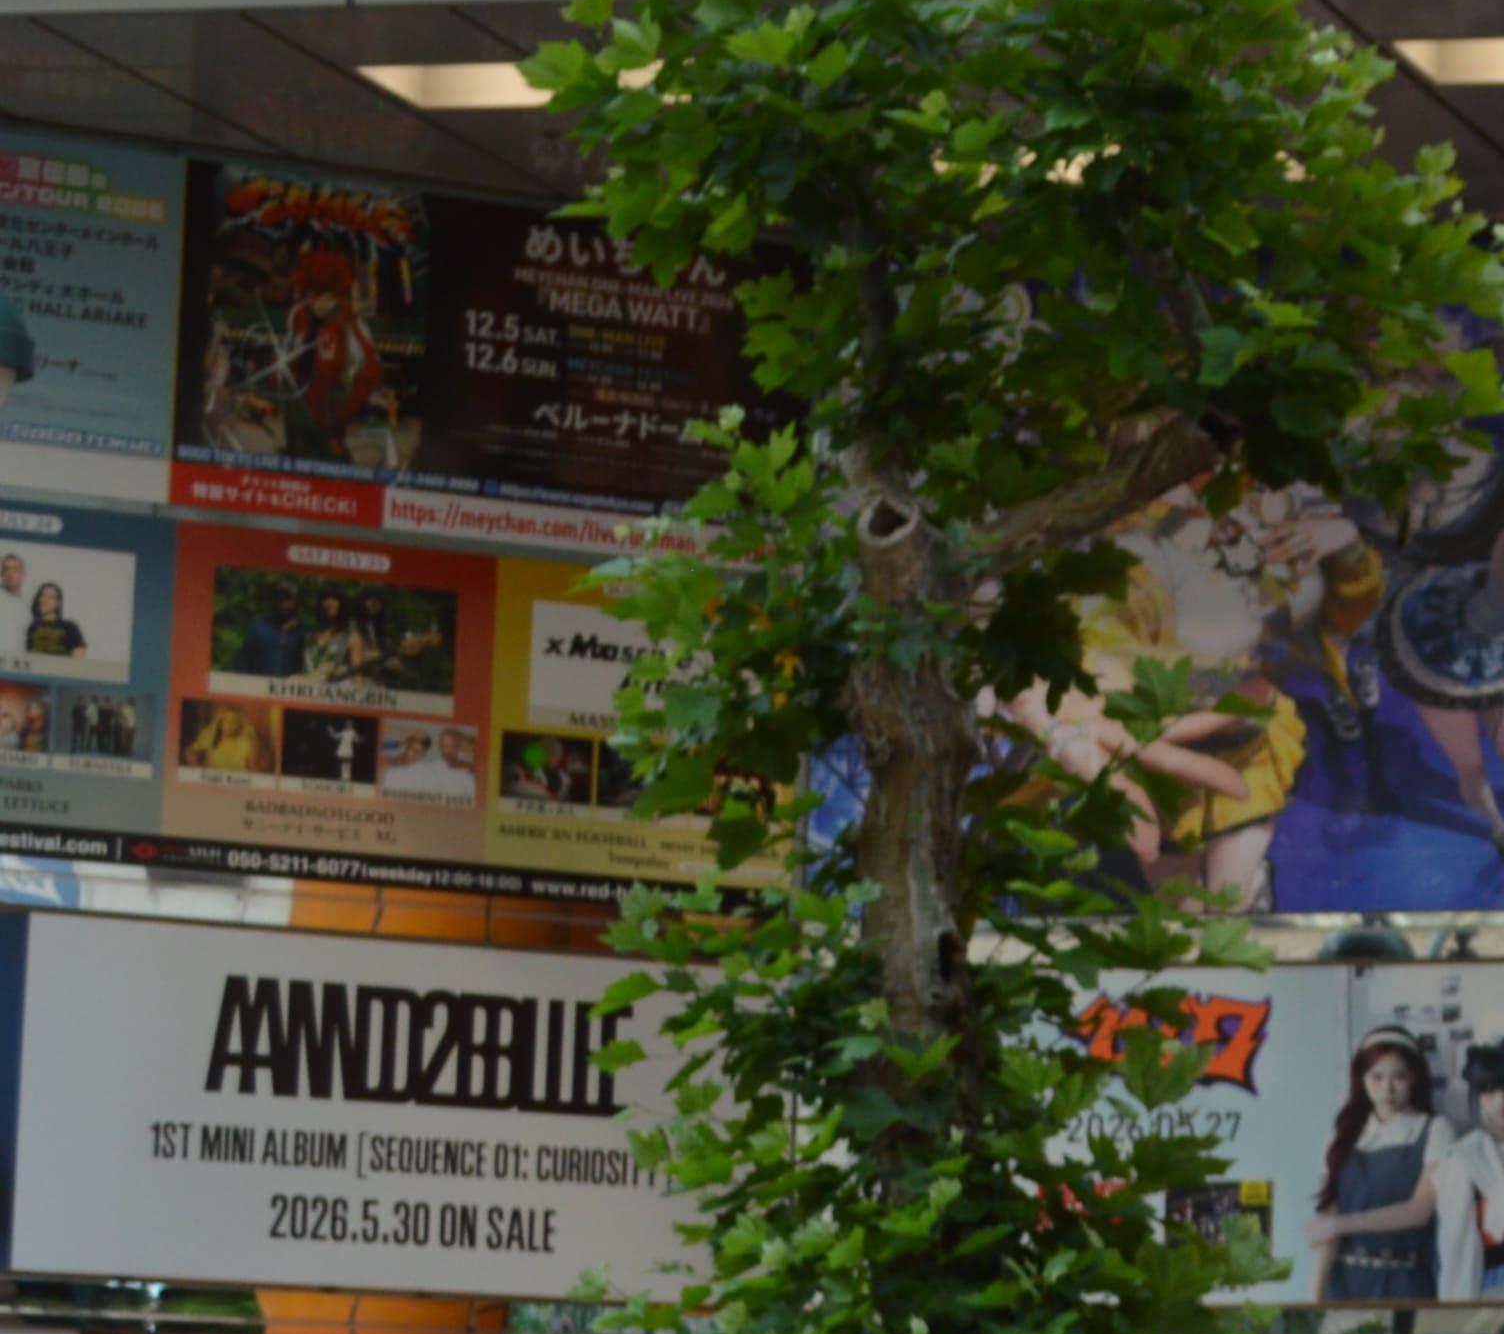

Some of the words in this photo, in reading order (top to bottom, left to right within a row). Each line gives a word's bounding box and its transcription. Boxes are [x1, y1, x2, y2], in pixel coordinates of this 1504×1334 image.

[465, 308, 521, 342] 12.5
[464, 341, 519, 375] 12.6
[267, 680, 399, 709] KHRUANGBIN
[150, 1122, 193, 1162] 1ST
[201, 1124, 255, 1164] MINI
[261, 1130, 348, 1169] ALBUM
[357, 1131, 486, 1180] [SEQUENCE
[493, 1143, 529, 1181] 01:
[269, 1193, 431, 1247] 2026.5.30
[439, 1204, 478, 1250] ON
[487, 1207, 557, 1253] SALE
